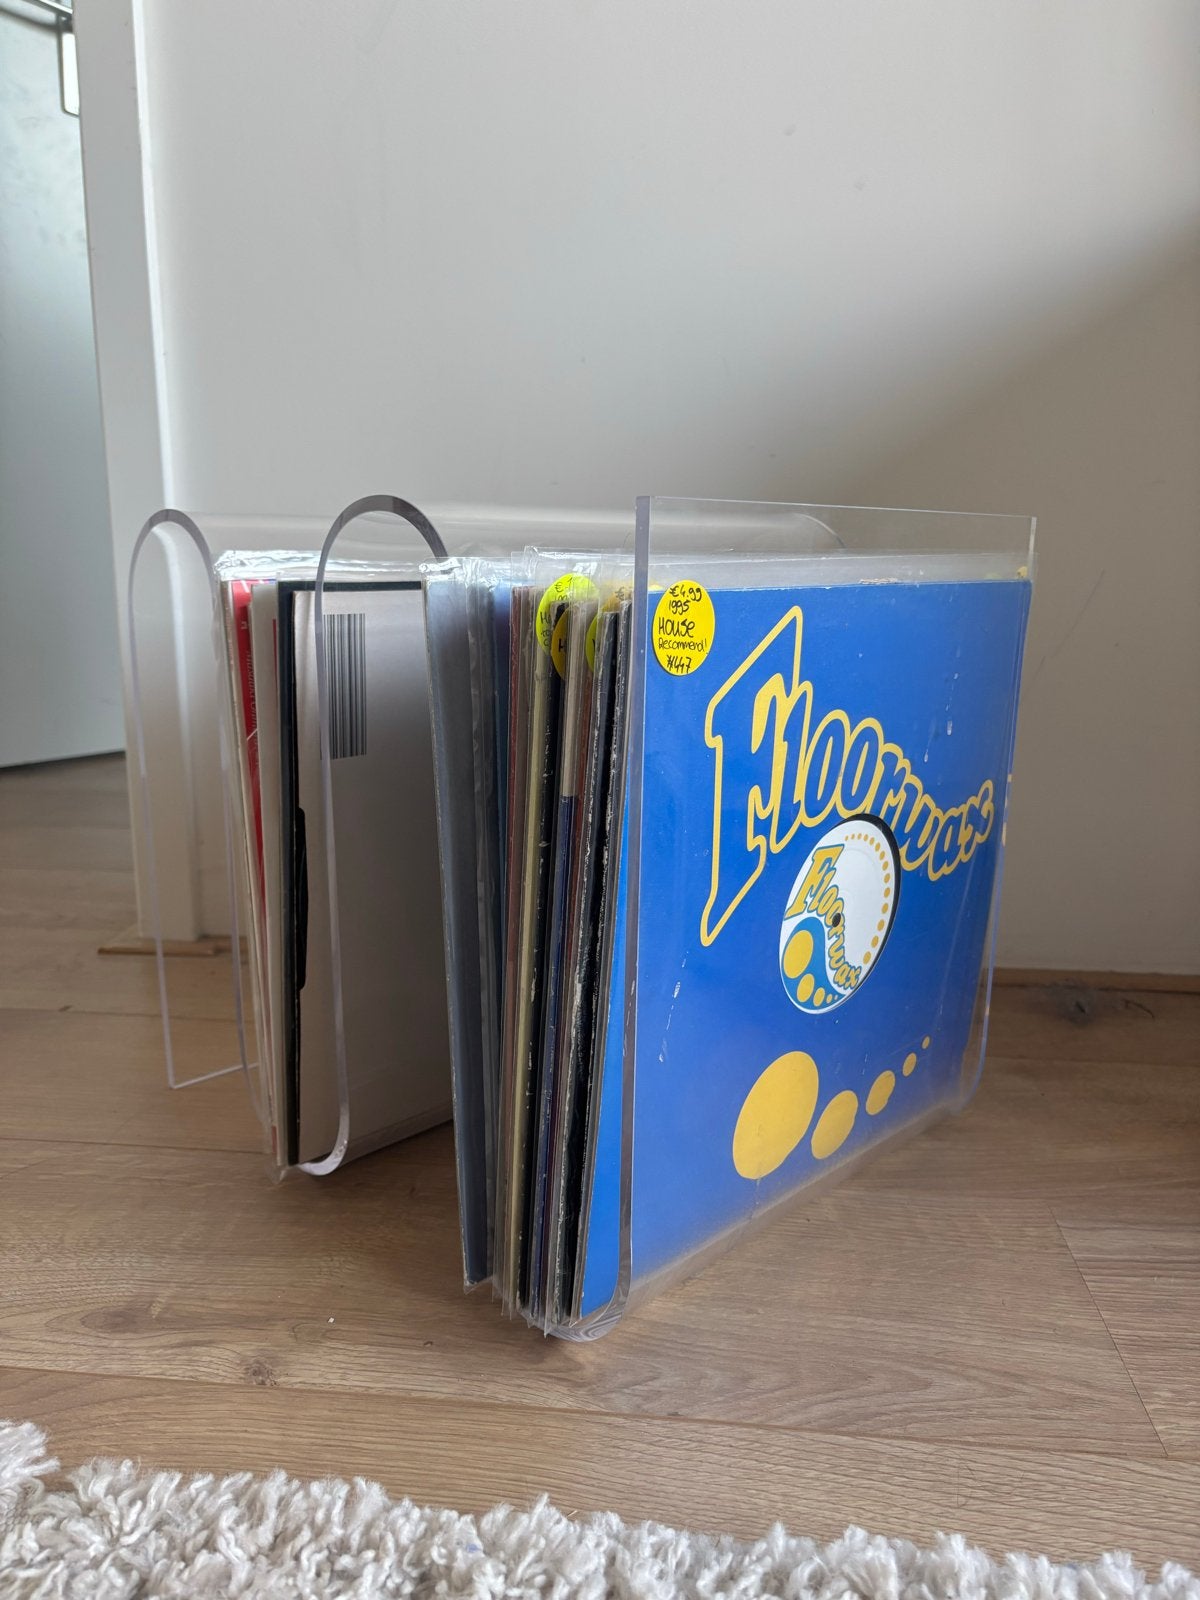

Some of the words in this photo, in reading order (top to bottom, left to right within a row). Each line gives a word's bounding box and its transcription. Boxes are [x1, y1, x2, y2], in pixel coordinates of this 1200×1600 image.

[668, 599, 691, 615] 1995
[700, 605, 994, 946] Floorwax
[783, 843, 862, 990] Floorwax
